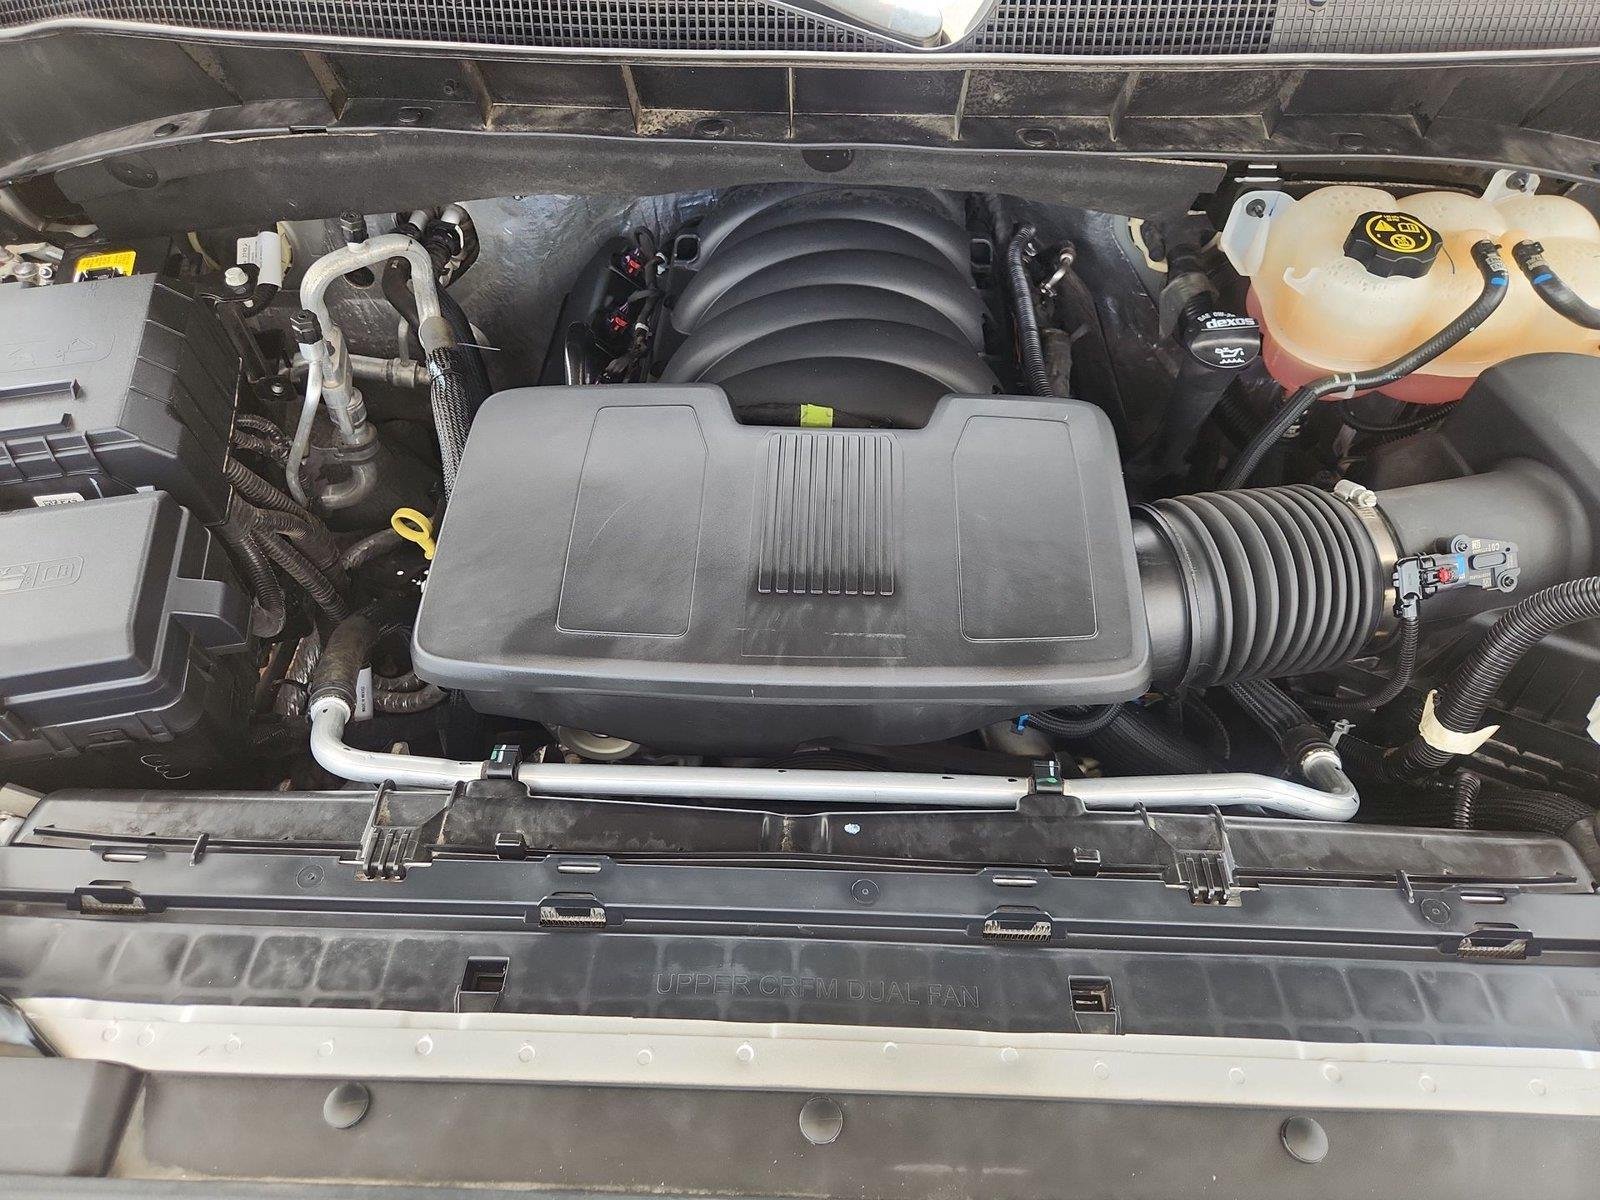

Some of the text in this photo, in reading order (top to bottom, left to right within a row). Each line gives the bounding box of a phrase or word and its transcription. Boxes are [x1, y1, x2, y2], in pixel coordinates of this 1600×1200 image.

[1206, 318, 1255, 328] dexos
[656, 973, 980, 1008] UPPER CRFM DUAL FAN
